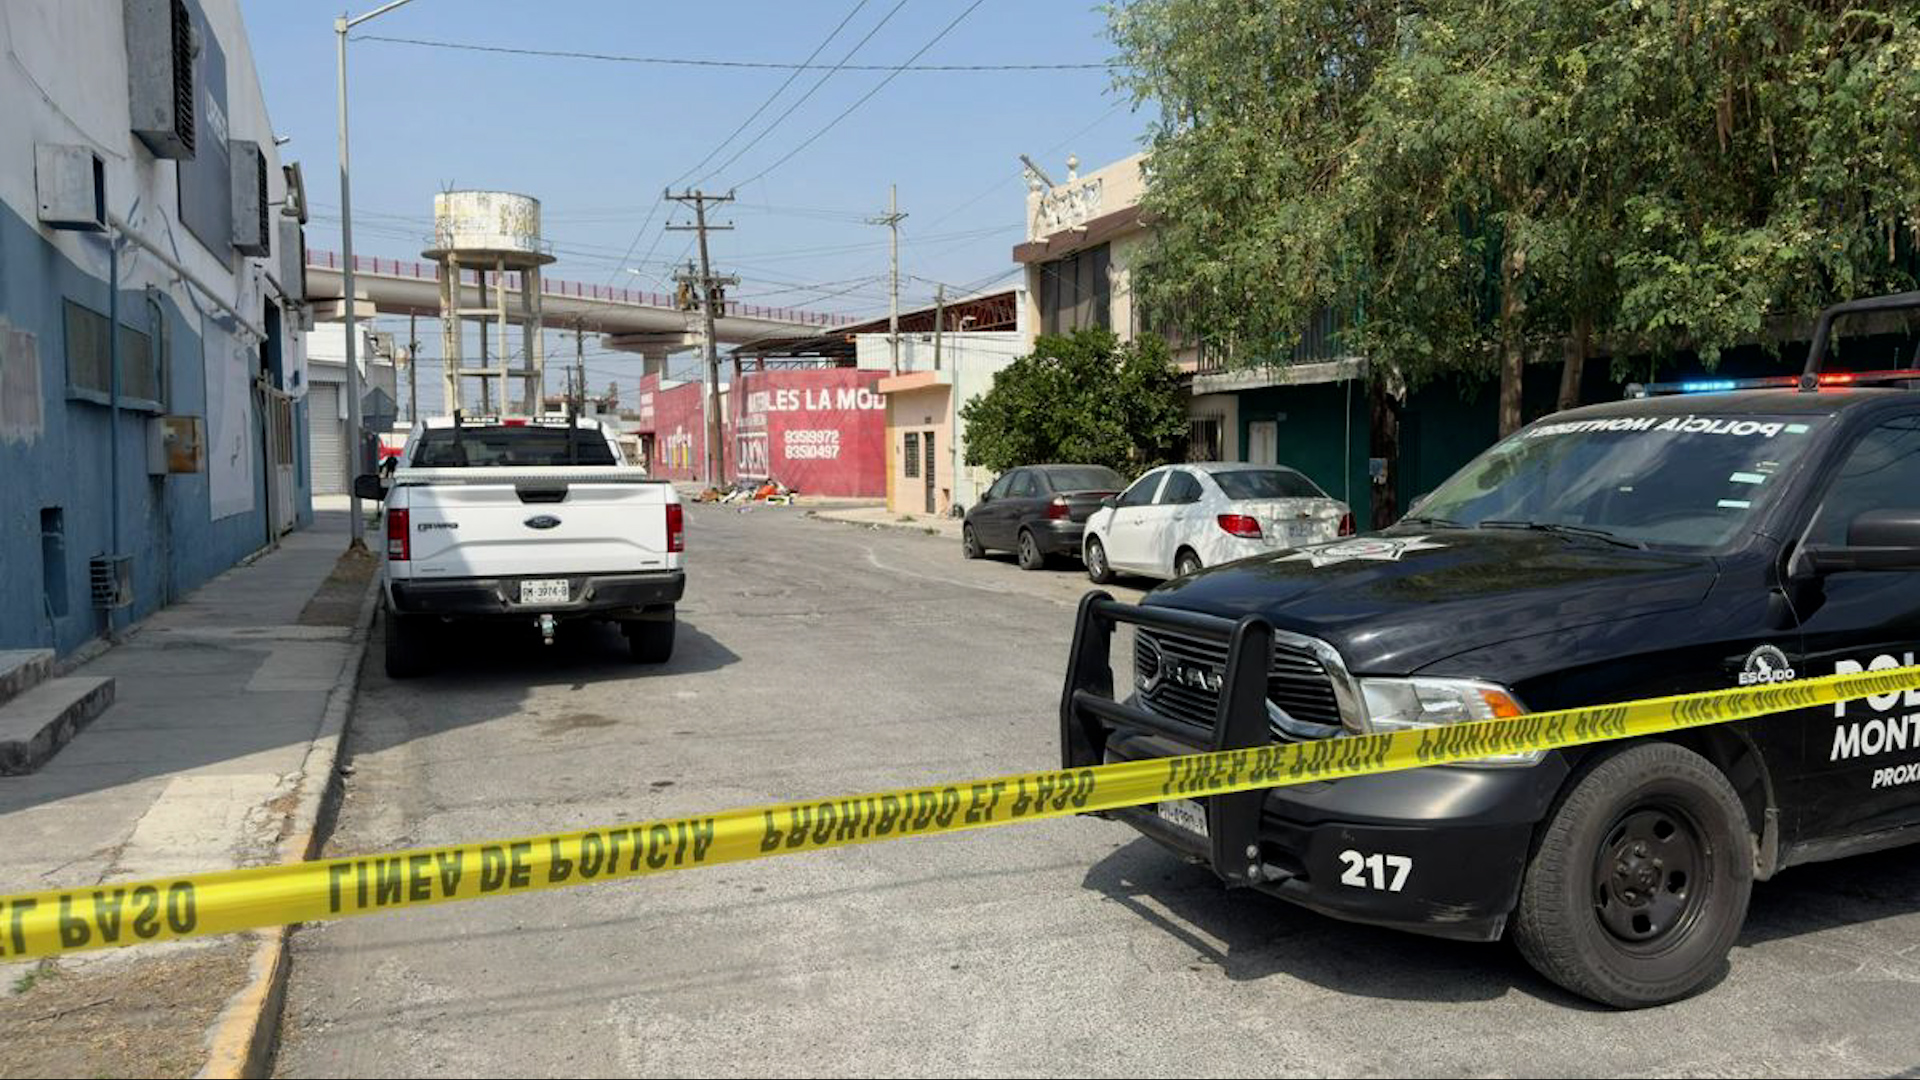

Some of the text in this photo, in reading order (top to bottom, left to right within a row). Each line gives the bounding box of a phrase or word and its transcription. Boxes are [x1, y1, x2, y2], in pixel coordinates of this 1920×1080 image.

[805, 388, 831, 410] LA
[1738, 668, 1795, 685] ESCUDO
[1338, 849, 1413, 892] 217
